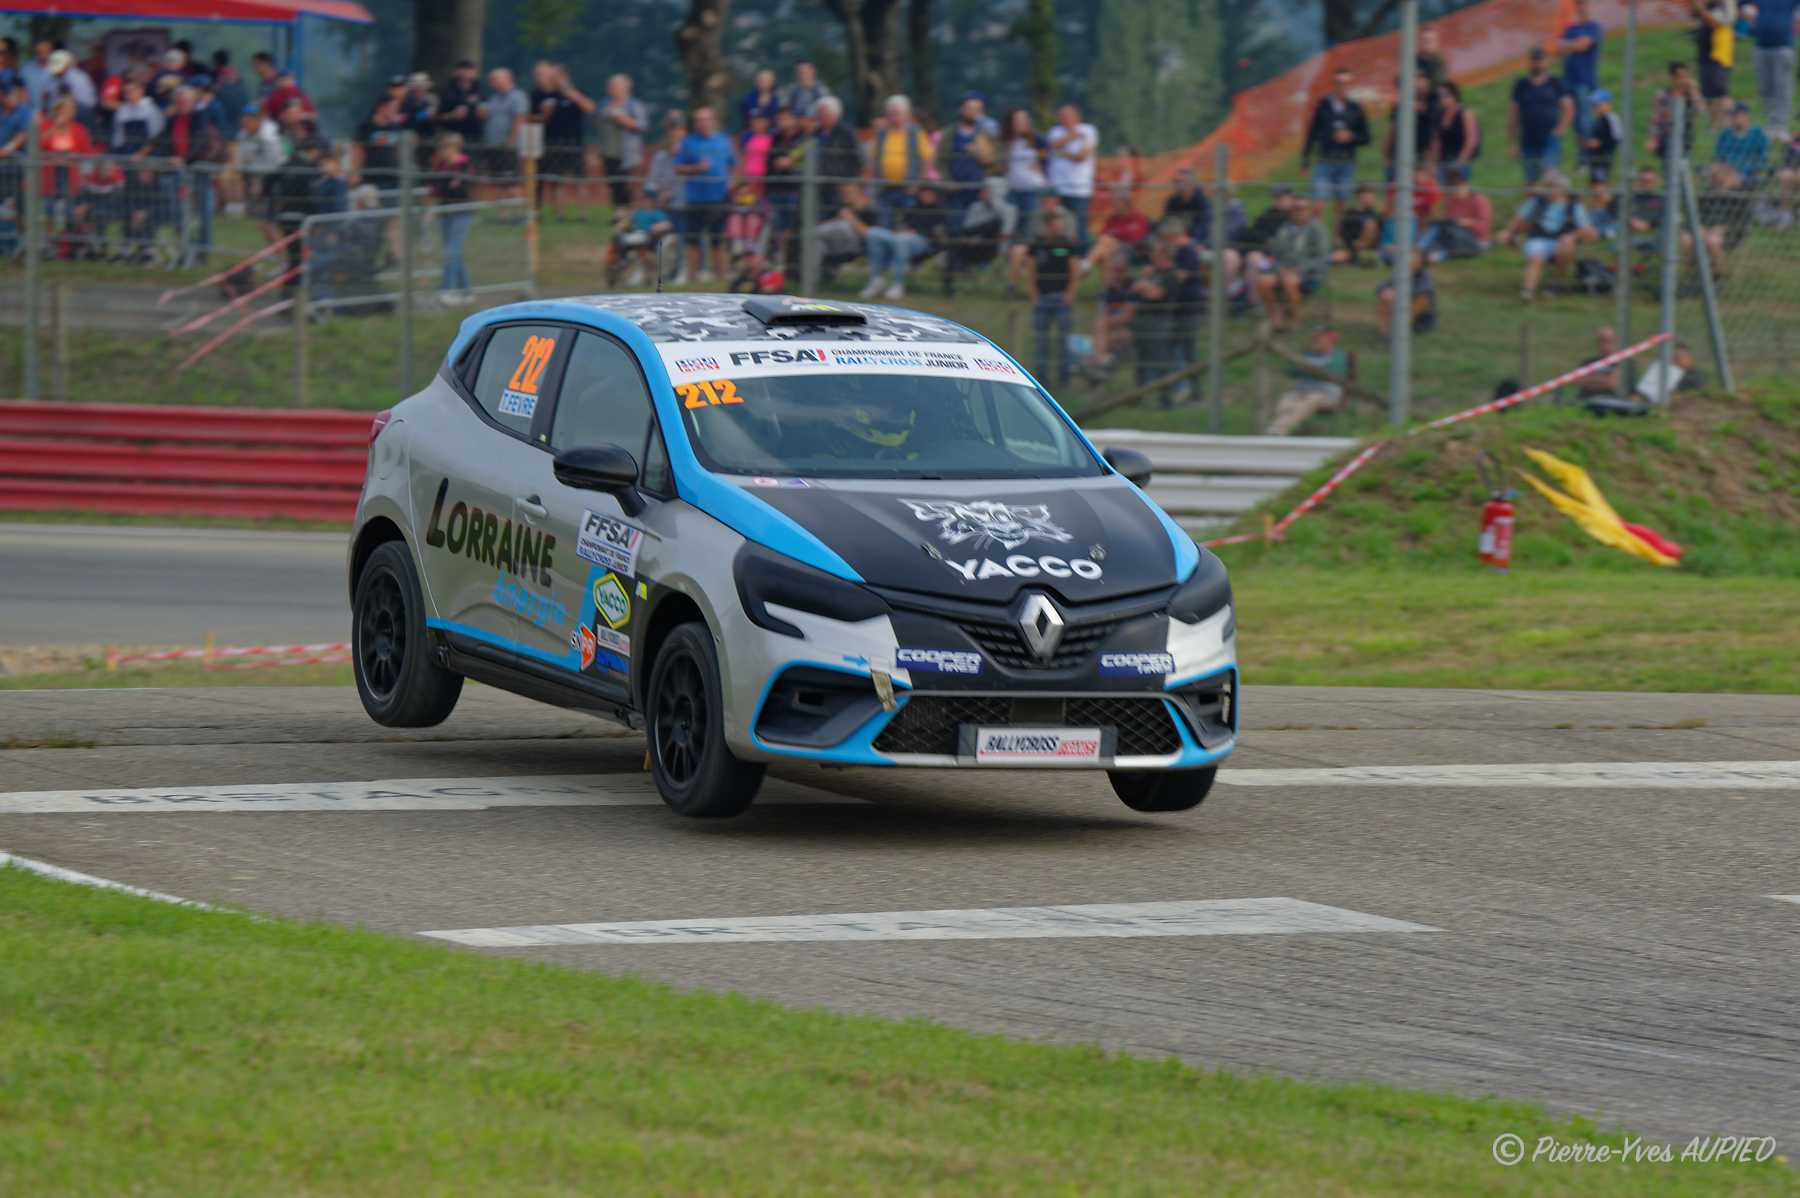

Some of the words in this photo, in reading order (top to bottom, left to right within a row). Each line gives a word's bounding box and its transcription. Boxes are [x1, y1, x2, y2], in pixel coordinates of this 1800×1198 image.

[508, 335, 556, 393] 212
[729, 349, 819, 366] FFSA
[831, 348, 905, 358] CHAMPIONNAT
[907, 350, 920, 358] DE
[924, 351, 963, 361] FRANCE
[925, 358, 969, 371] JUNIOR
[675, 379, 744, 409] 212
[426, 477, 557, 588] LORRAINE
[585, 514, 630, 548] FFSA
[944, 554, 1104, 581] YACCO
[599, 590, 625, 614] YACCO
[897, 649, 982, 665] COOPER
[1101, 653, 1174, 668] COOPER
[938, 661, 980, 674] TIRES
[987, 734, 1060, 753] RALLYCROSS
